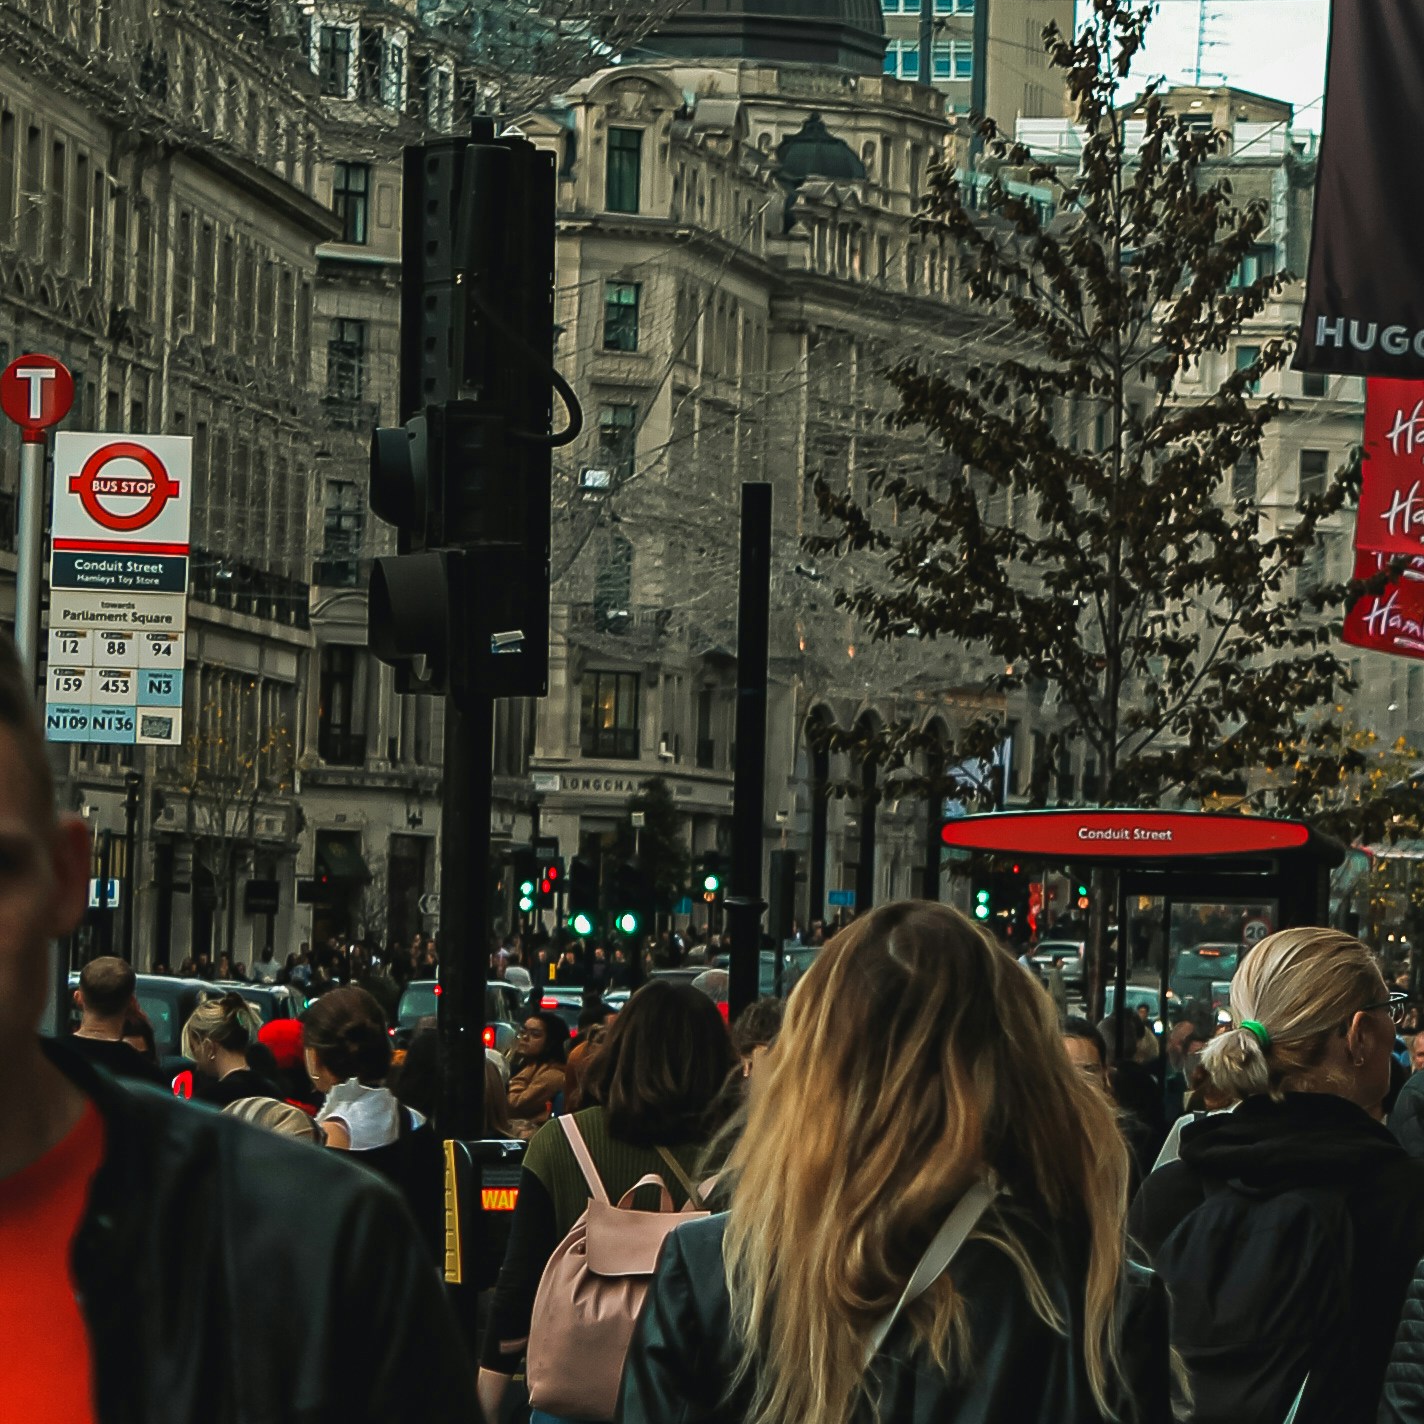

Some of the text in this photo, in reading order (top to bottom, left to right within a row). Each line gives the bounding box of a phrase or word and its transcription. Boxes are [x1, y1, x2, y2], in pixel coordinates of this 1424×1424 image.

[16, 368, 56, 419] T
[92, 480, 156, 494] BUS STOP
[74, 559, 164, 574] Conduit Street
[77, 574, 160, 585] Hamleys Toy Store
[101, 601, 136, 610] towards
[63, 609, 173, 625] Parliament Square
[62, 639, 79, 654] 12
[106, 641, 126, 655] 88
[151, 642, 172, 657] 94
[54, 677, 83, 692] 159
[100, 679, 130, 694] 453
[148, 679, 172, 695] N3
[47, 714, 88, 730] N109
[92, 716, 134, 731] N136
[1078, 827, 1172, 841] Conduit Street
[1245, 925, 1268, 939] 20
